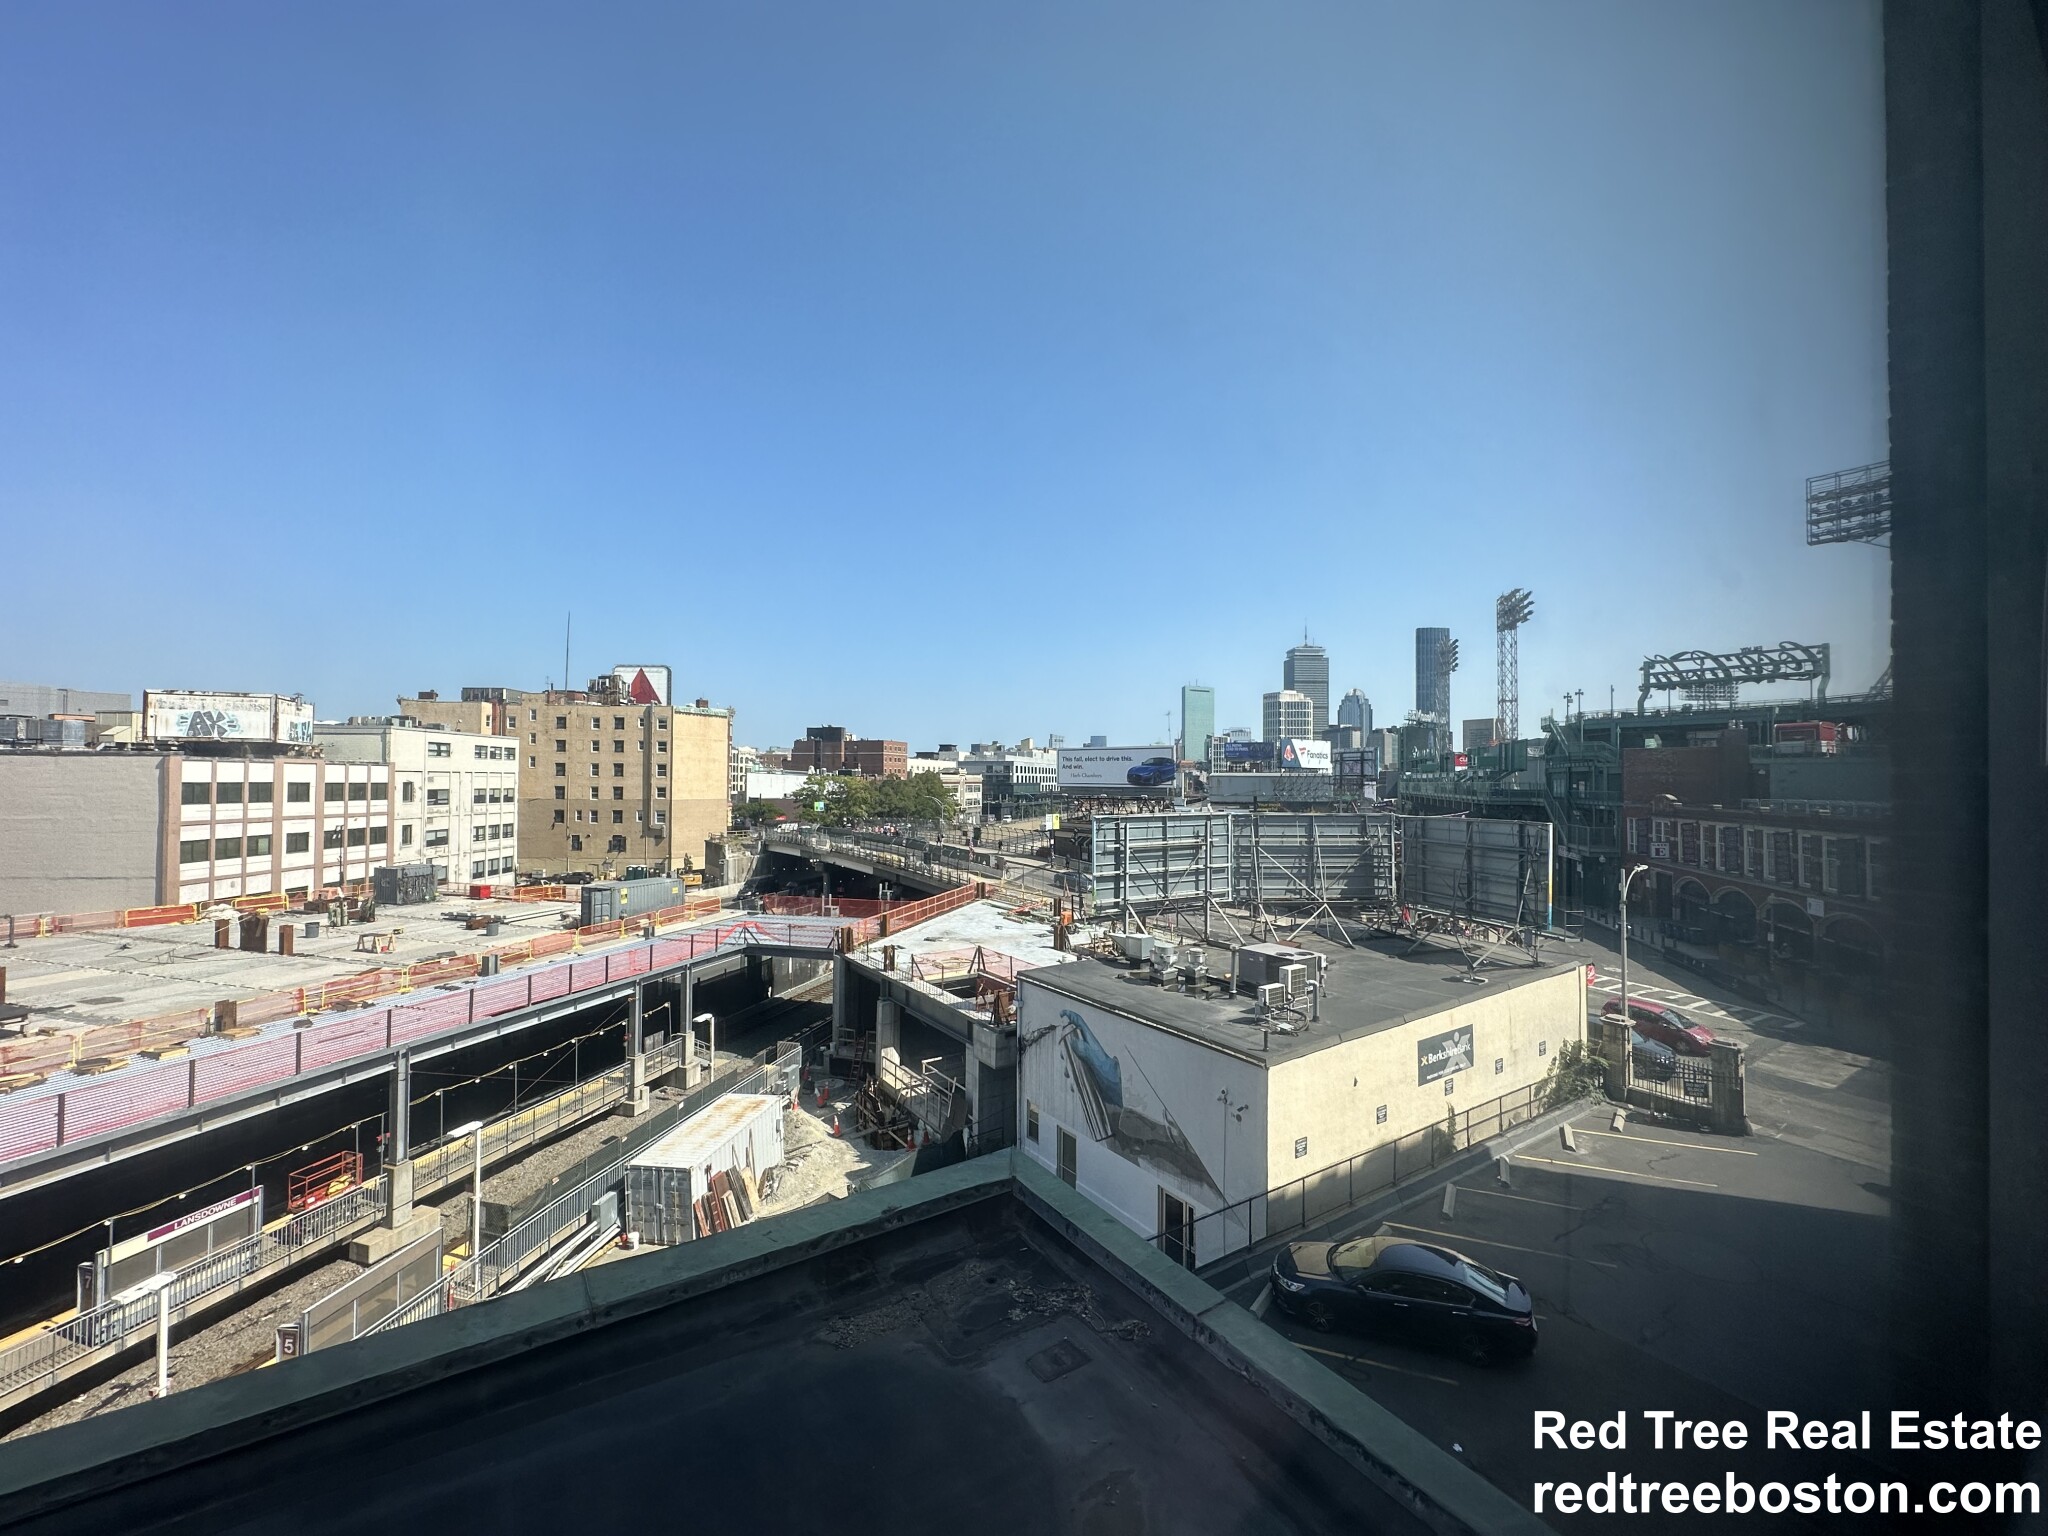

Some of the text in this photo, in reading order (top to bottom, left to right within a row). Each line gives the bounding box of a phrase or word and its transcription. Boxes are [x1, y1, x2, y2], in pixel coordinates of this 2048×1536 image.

[1306, 750, 1329, 760] Fanatics
[1428, 1041, 1471, 1064] BerkshireBank
[174, 1198, 237, 1230] LANSDOWNE
[84, 1274, 93, 1290] 7
[284, 1338, 295, 1354] 5
